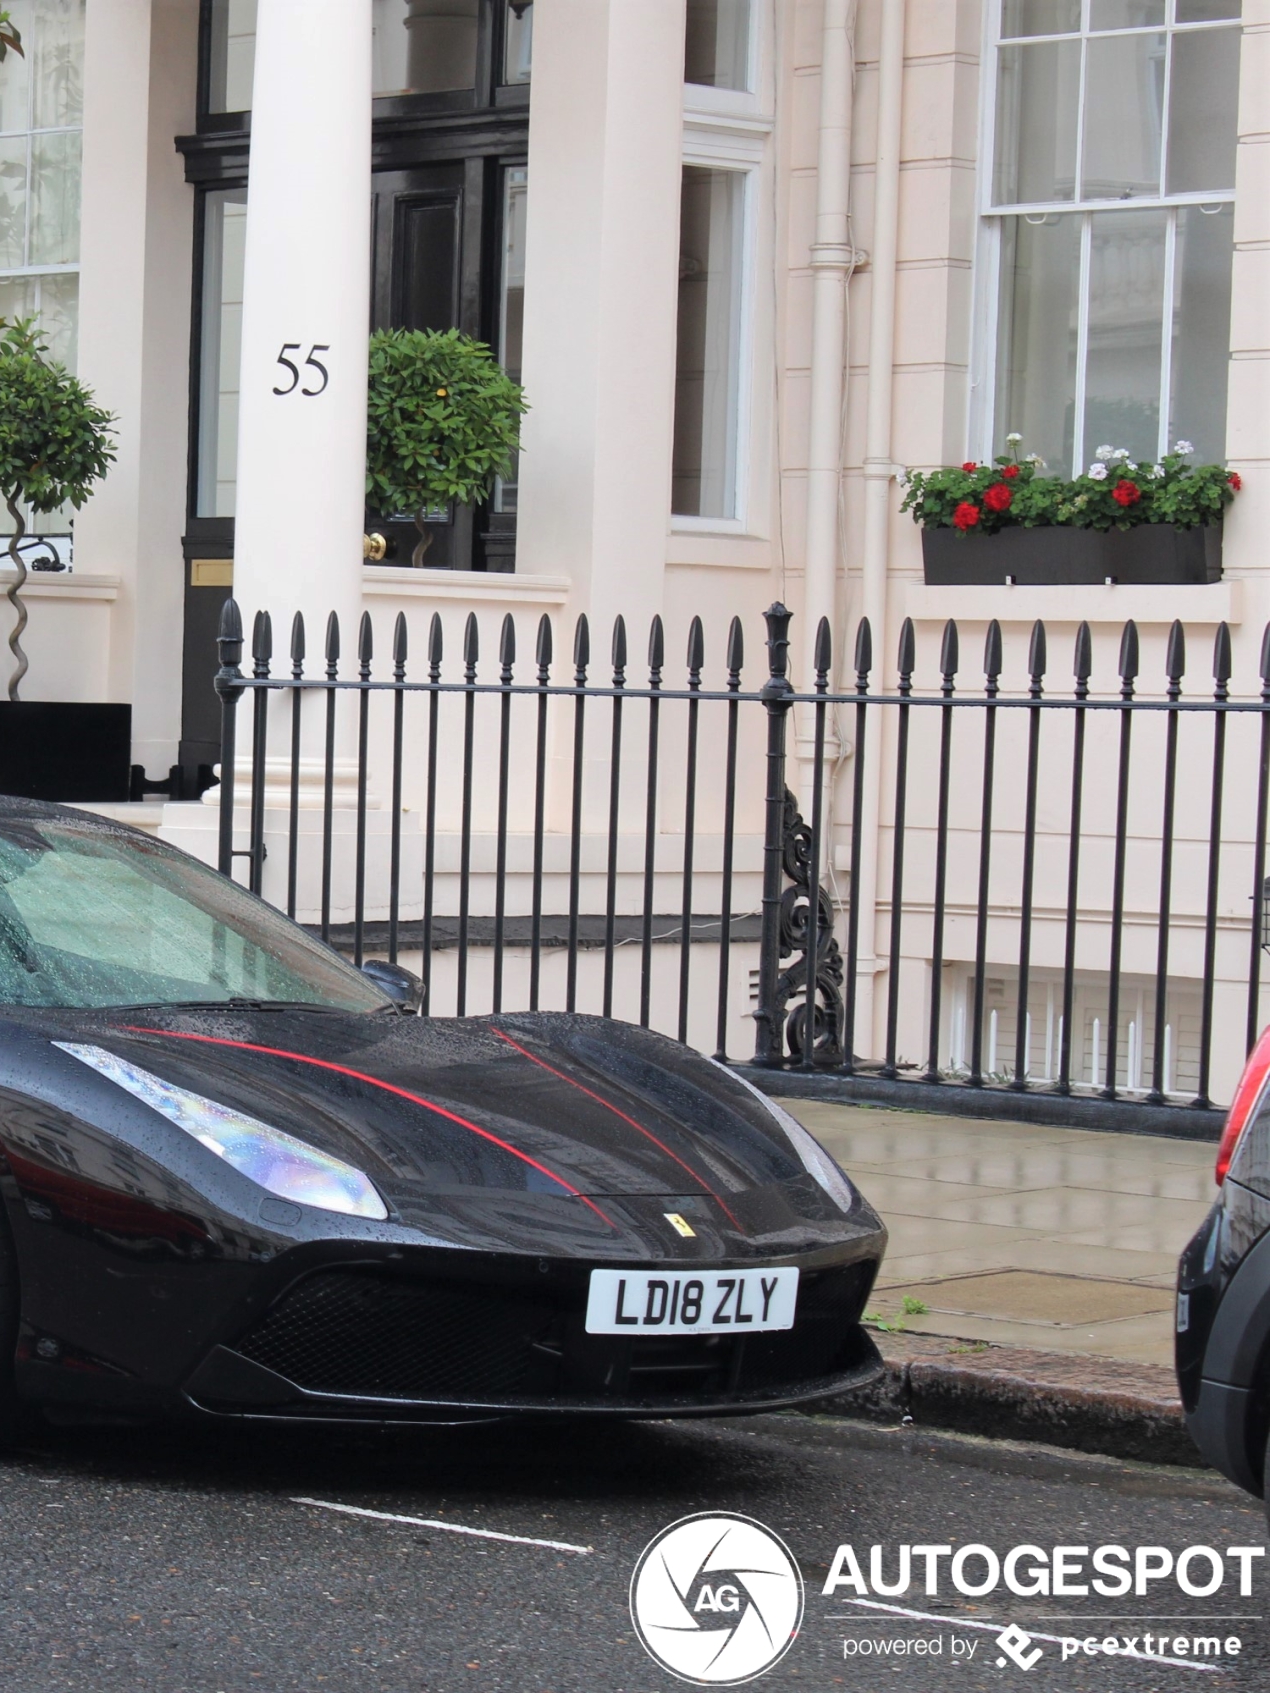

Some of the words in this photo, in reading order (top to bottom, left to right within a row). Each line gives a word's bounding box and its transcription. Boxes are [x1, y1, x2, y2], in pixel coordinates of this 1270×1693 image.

[272, 343, 331, 397] 55
[614, 1278, 704, 1325] LD18
[712, 1276, 779, 1325] ZLY
